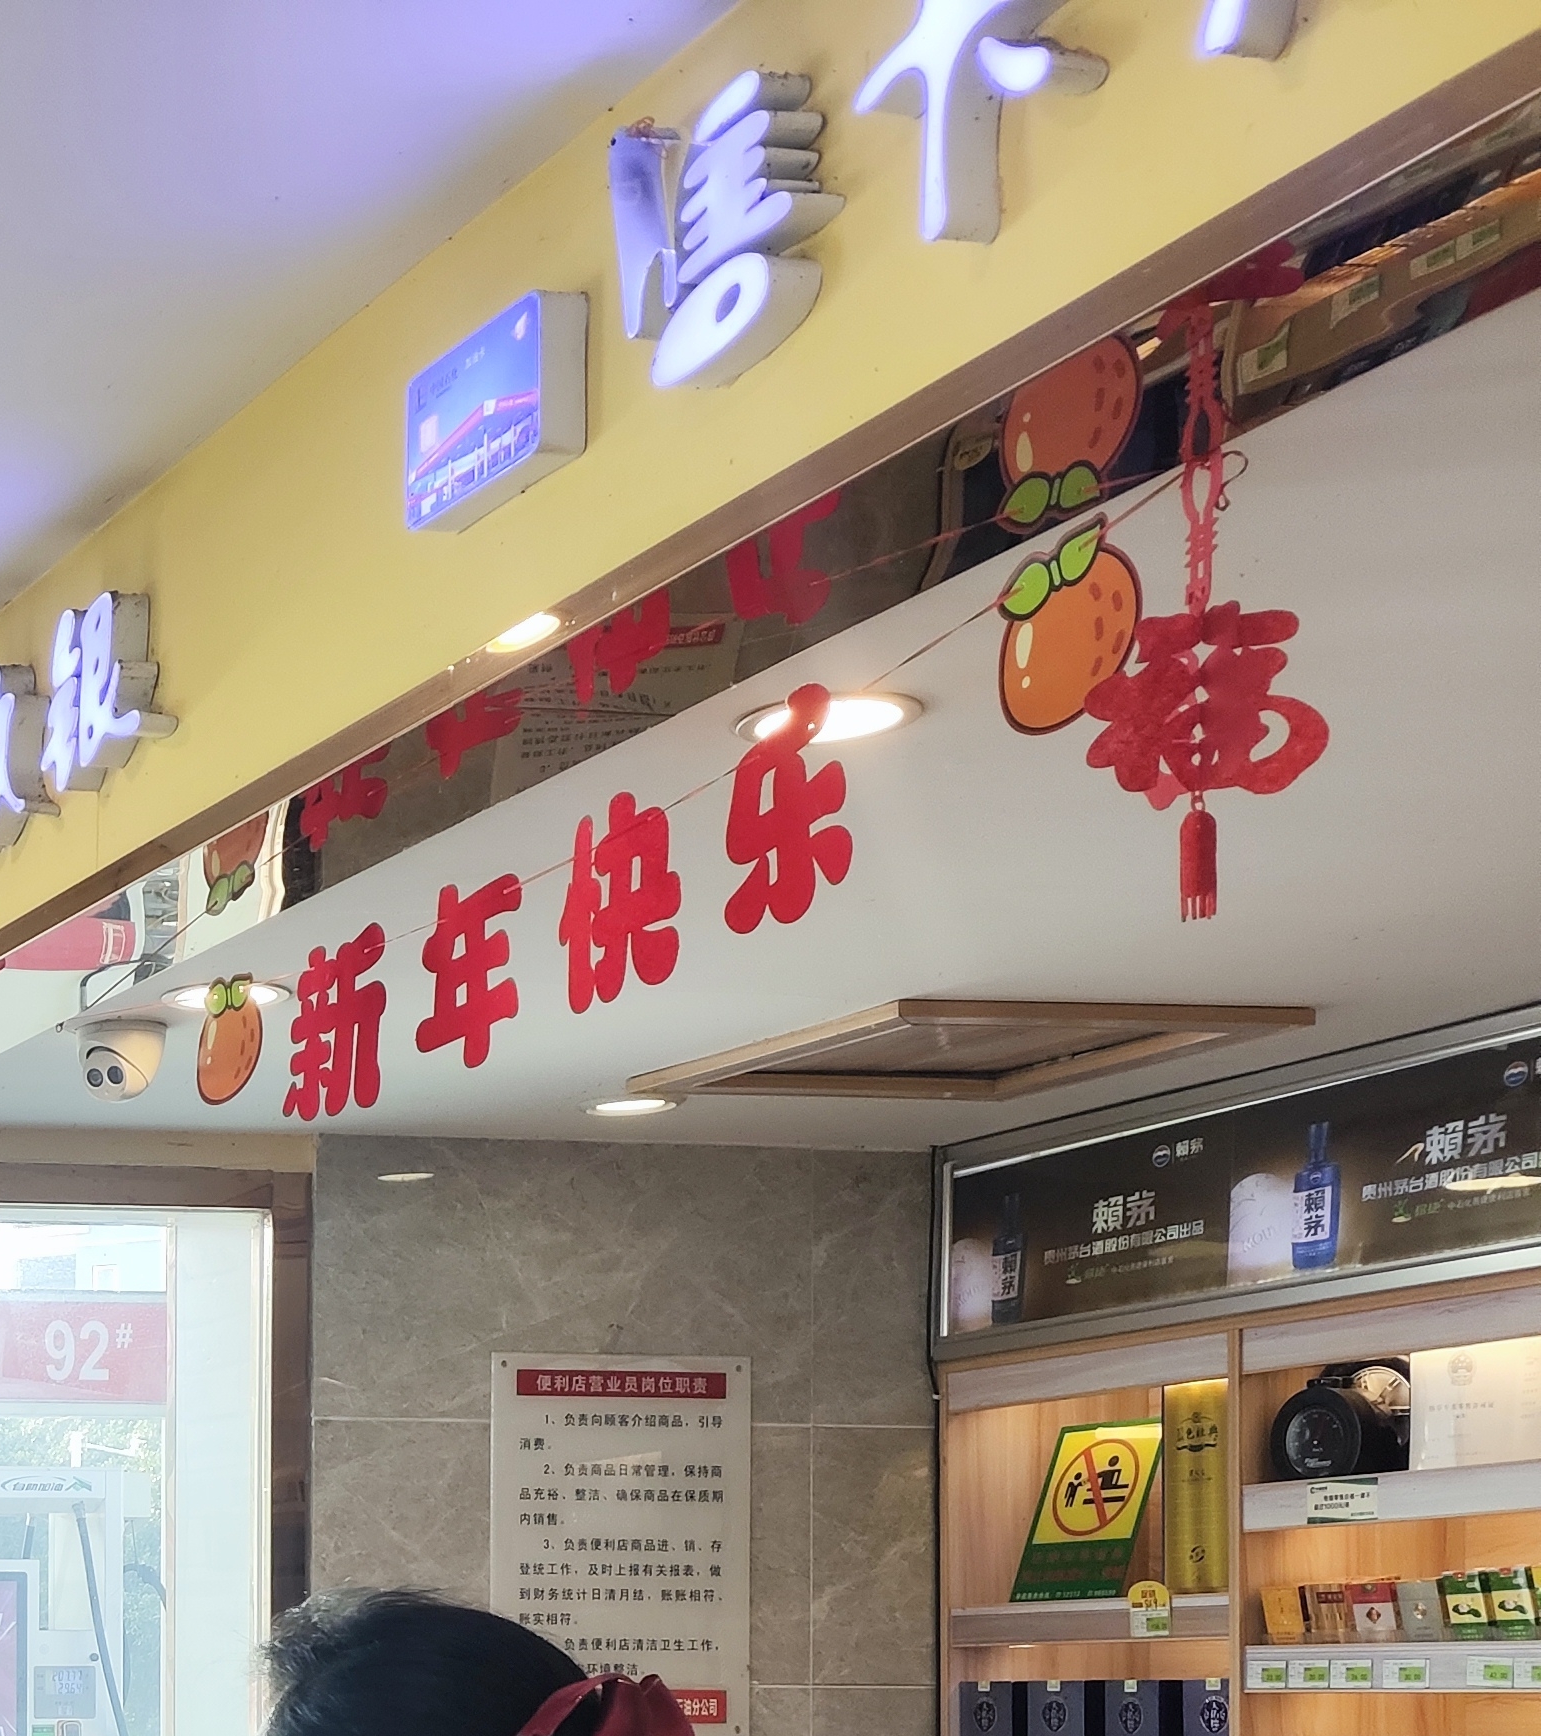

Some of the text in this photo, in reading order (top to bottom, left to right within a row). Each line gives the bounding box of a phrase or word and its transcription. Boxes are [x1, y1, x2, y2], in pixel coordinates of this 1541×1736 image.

[284, 684, 855, 1121] 新年快乐
[1044, 1220, 1205, 1265] 贵州茅台酒股份有限公司出品
[45, 1319, 134, 1381] 92#
[537, 1375, 708, 1394] 便利店营业员岗位职责
